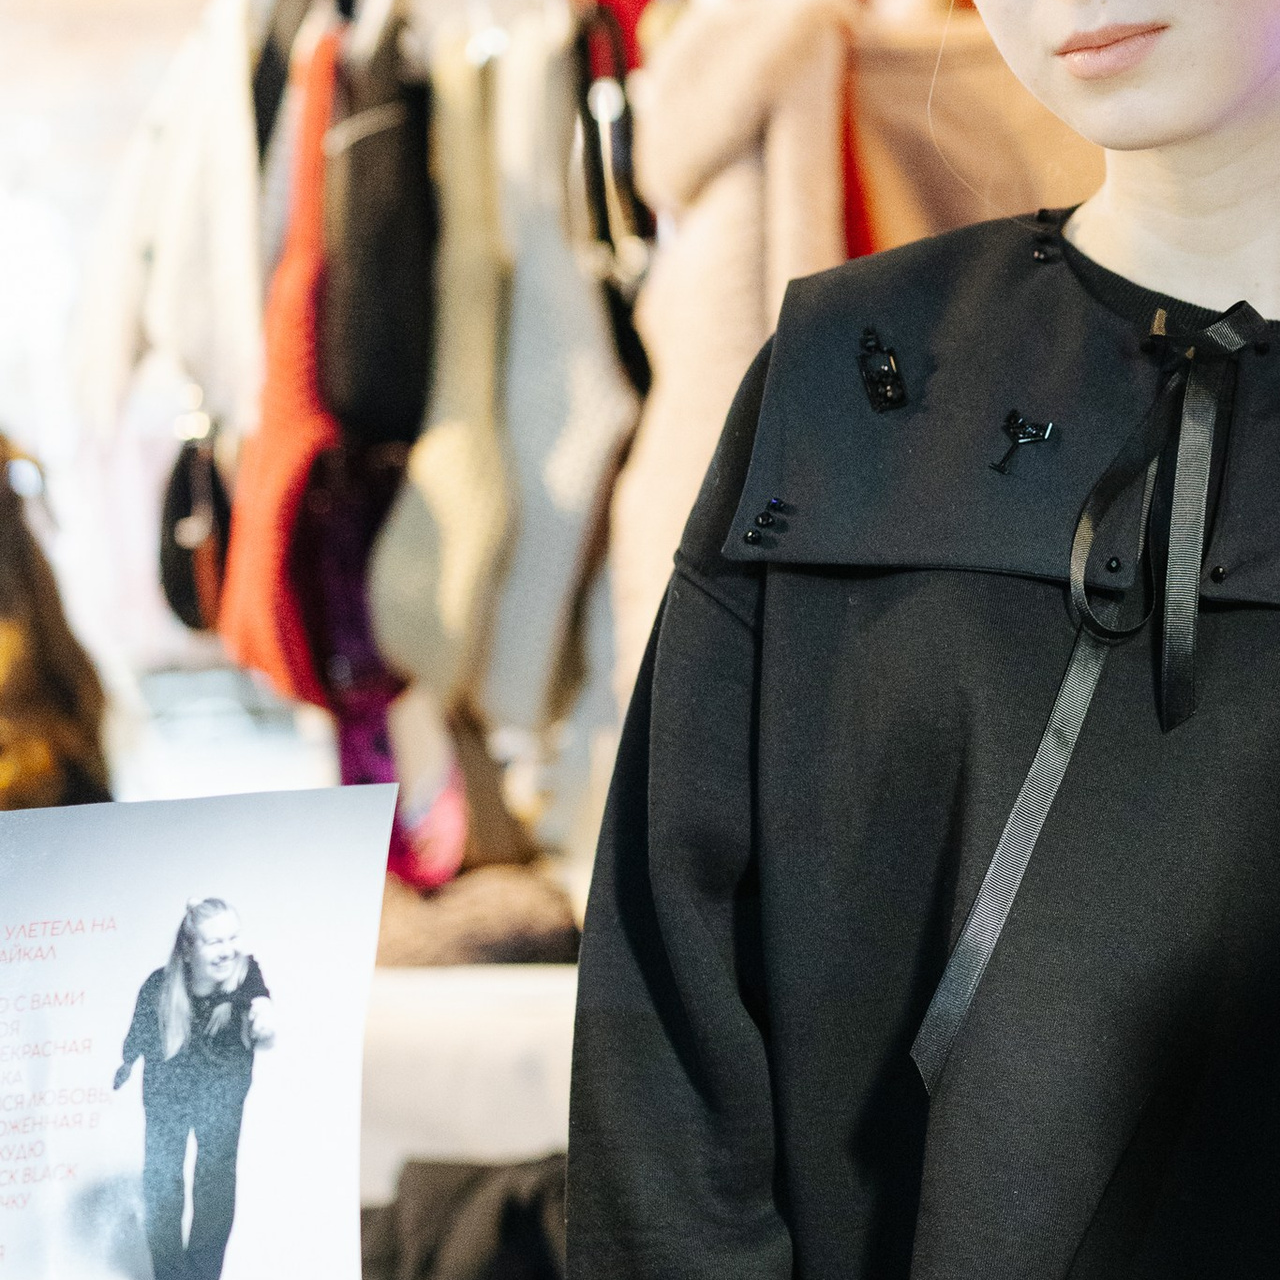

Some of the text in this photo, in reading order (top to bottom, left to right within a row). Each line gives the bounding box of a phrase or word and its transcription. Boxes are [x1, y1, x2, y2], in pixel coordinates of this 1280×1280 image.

[5, 917, 118, 940] УЛЕТЕЛА НА
[14, 995, 27, 1013] С
[31, 991, 86, 1011] ВАМИ
[0, 1093, 24, 1113] СЯ
